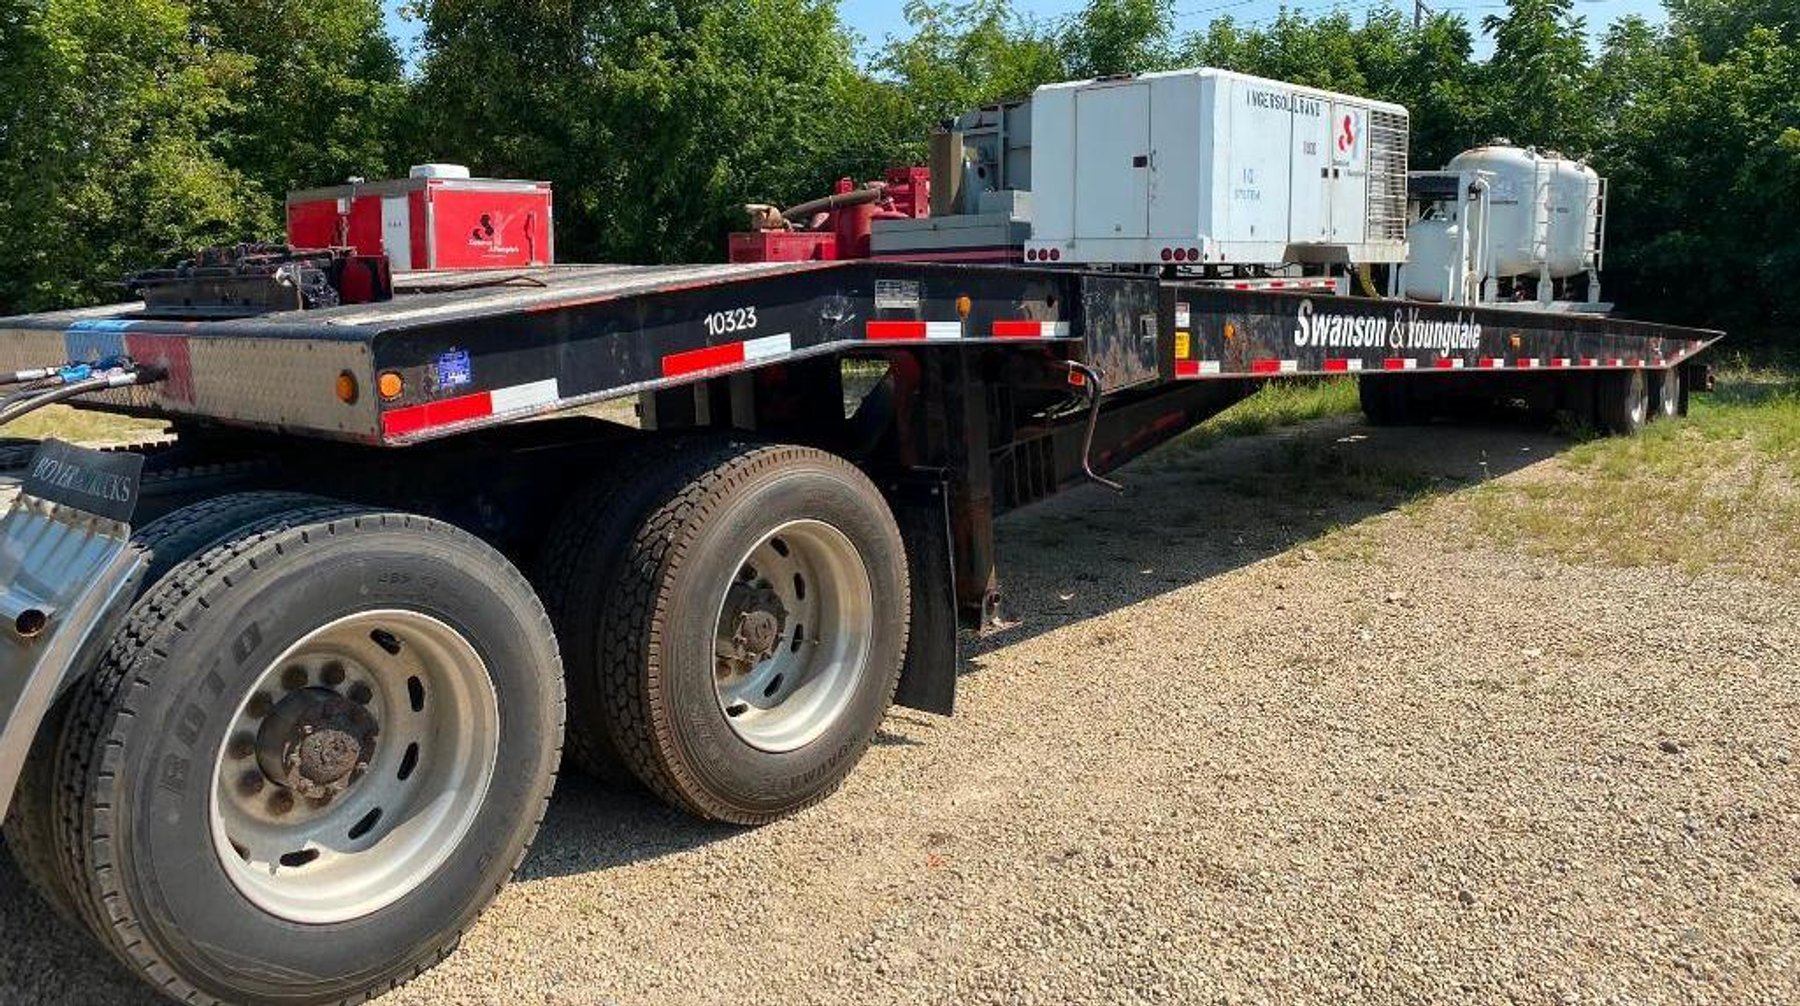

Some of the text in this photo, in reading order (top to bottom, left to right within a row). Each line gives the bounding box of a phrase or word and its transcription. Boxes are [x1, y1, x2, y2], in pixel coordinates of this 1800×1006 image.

[703, 306, 757, 336] 10323
[1294, 299, 1482, 358] Swanson & Youngdale
